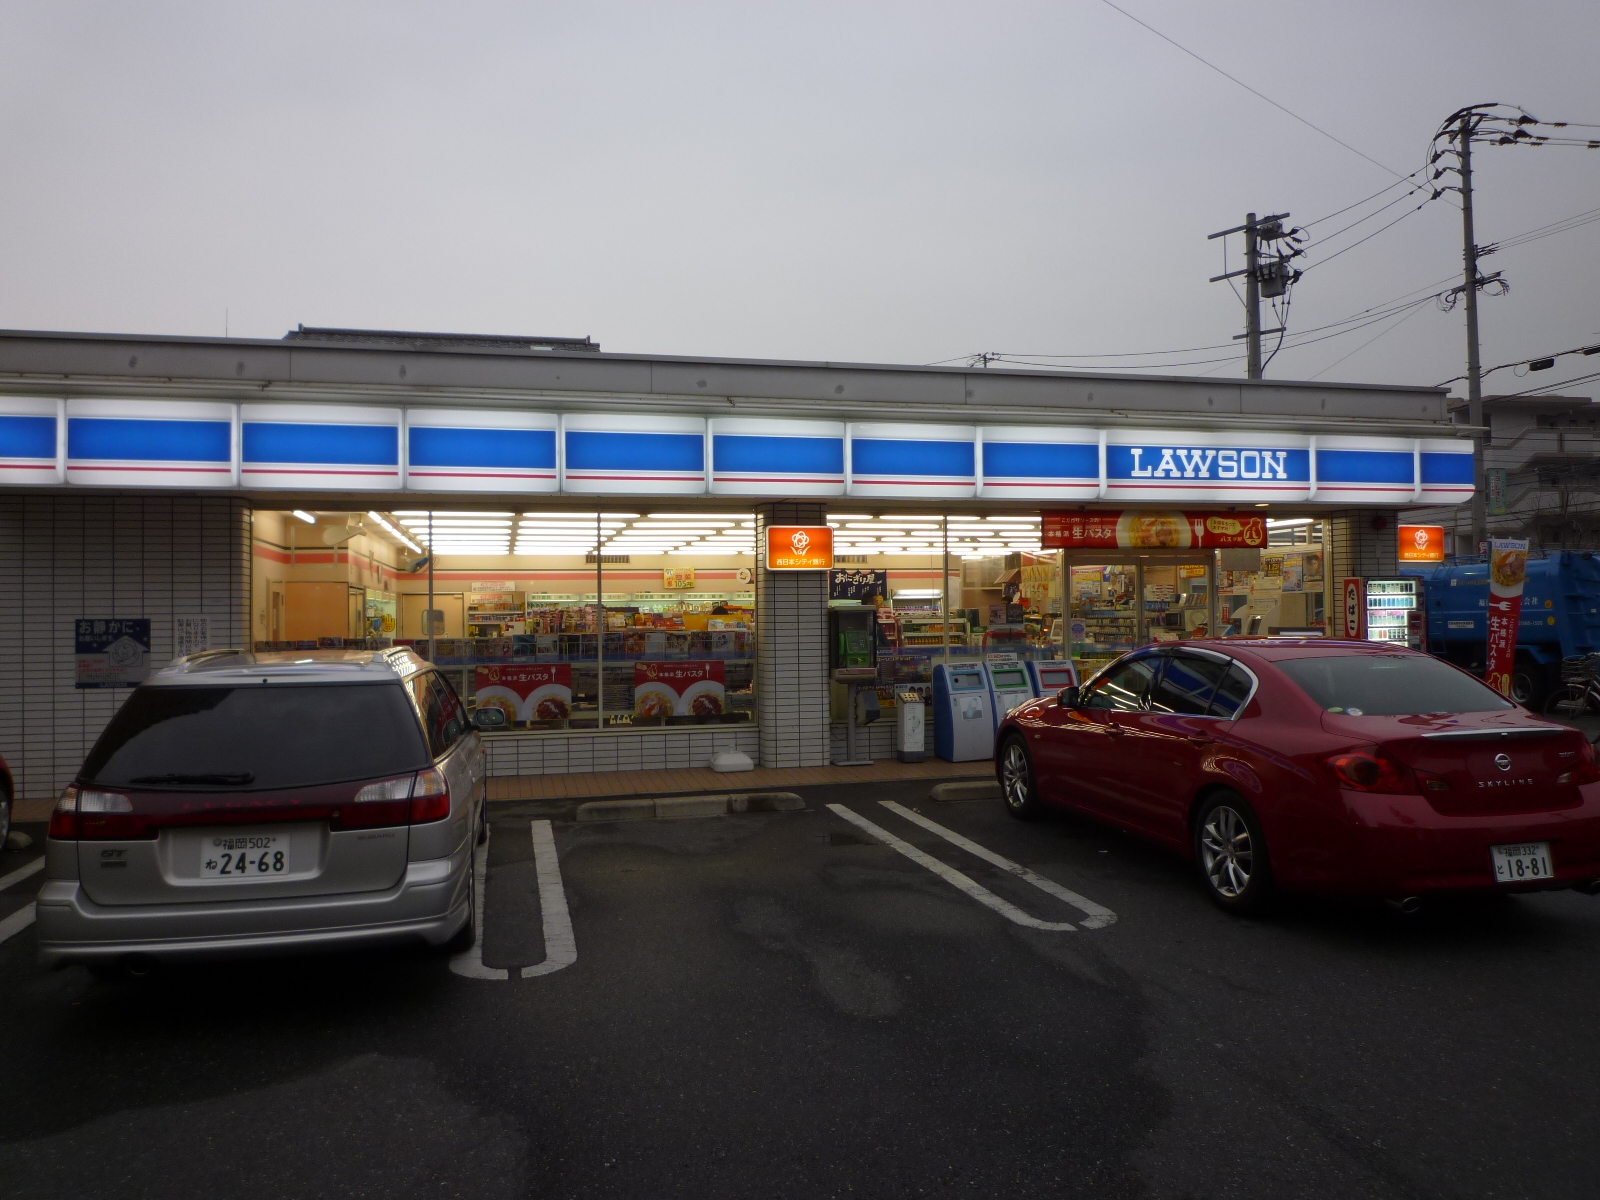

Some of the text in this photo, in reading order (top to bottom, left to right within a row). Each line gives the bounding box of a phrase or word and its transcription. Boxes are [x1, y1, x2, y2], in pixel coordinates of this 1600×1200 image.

[1130, 448, 1288, 479] LAWSON
[1071, 527, 1112, 539] 生パスタ
[1493, 541, 1527, 550] LAWSON
[776, 558, 826, 566] 西日本シティ銀行
[834, 572, 876, 585] おにぎり屋
[1347, 588, 1358, 631] たばこ
[79, 620, 134, 634] お静かに
[1498, 617, 1508, 649] 本格派
[1488, 615, 1501, 671] 生パスタ
[518, 673, 549, 682] 生パスタ
[675, 669, 704, 678] 生パスタ
[1478, 778, 1534, 788] SKYLINE
[356, 832, 396, 841] SUBARU
[205, 851, 285, 875] ね 24-68
[1496, 856, 1548, 878] と 18-81
